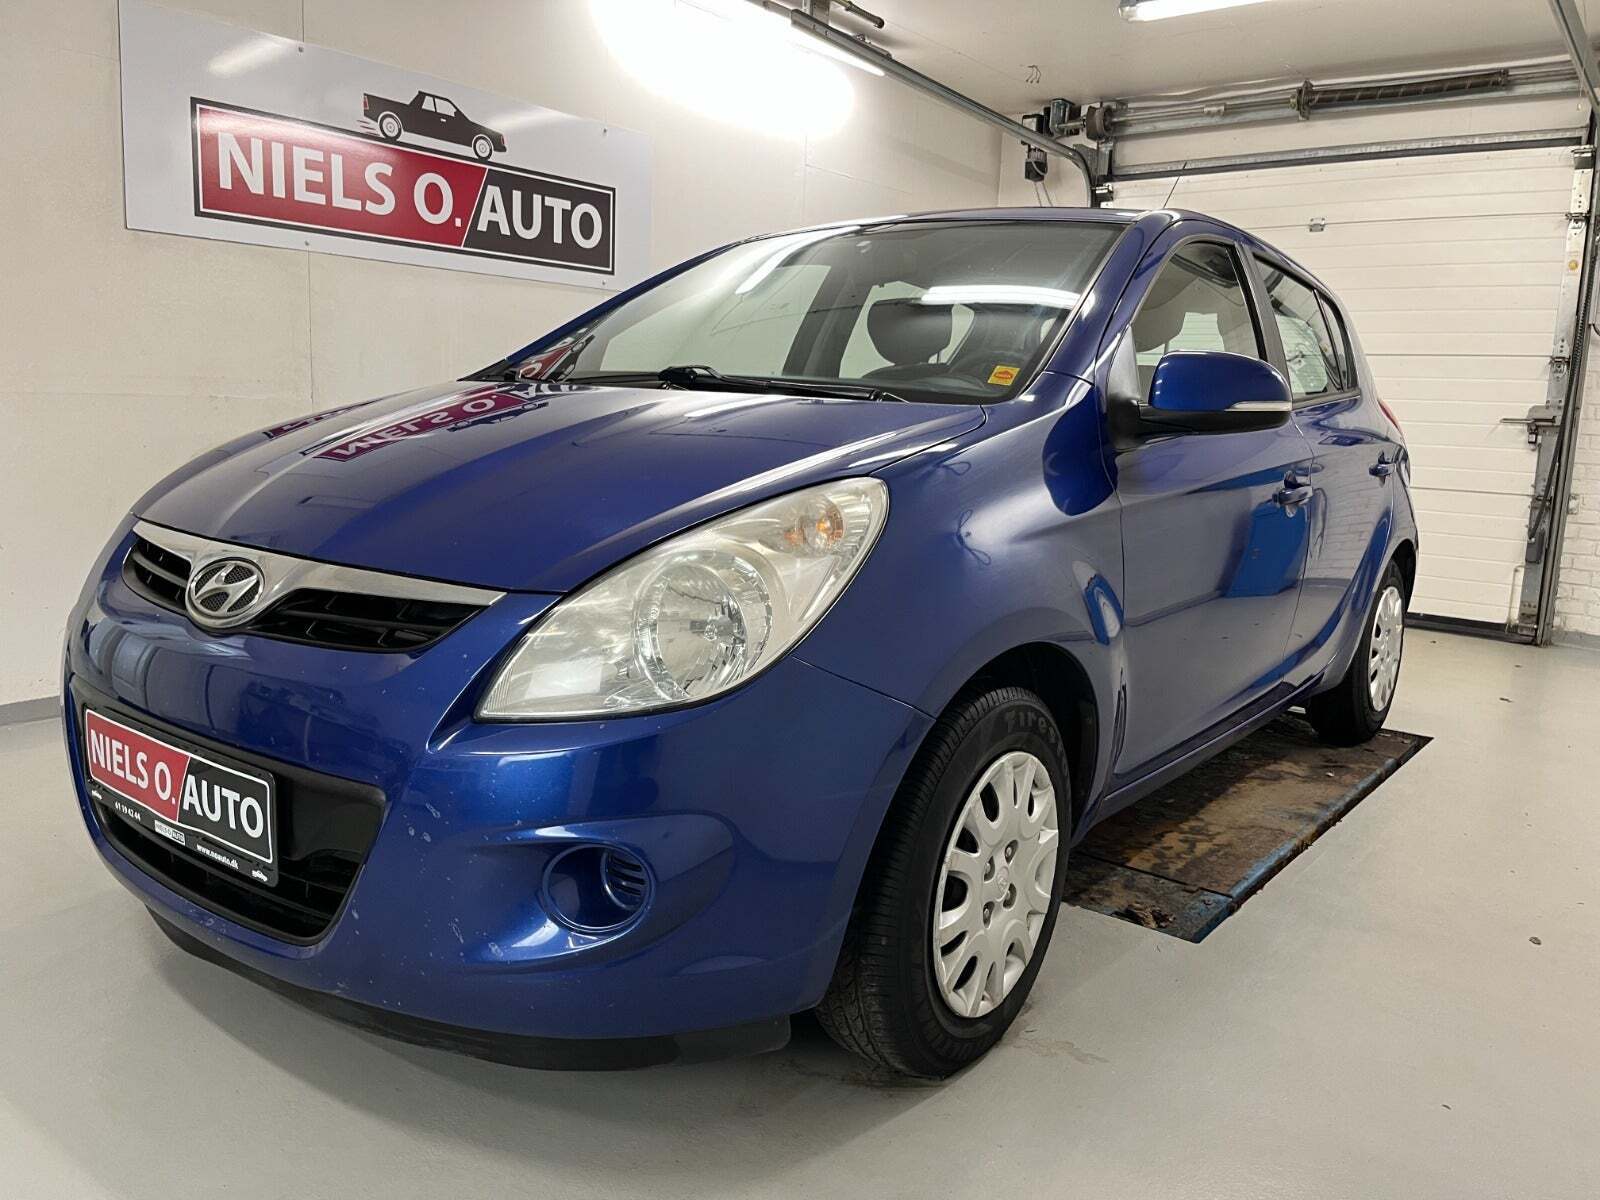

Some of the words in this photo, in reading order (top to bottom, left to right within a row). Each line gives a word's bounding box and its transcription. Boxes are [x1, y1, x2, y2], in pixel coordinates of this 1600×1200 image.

[217, 131, 396, 216] NIELS
[413, 172, 462, 228] O.
[477, 184, 602, 249] AUTO
[90, 729, 149, 789] NIELS
[154, 761, 176, 805] O.
[182, 774, 264, 838] AUTO
